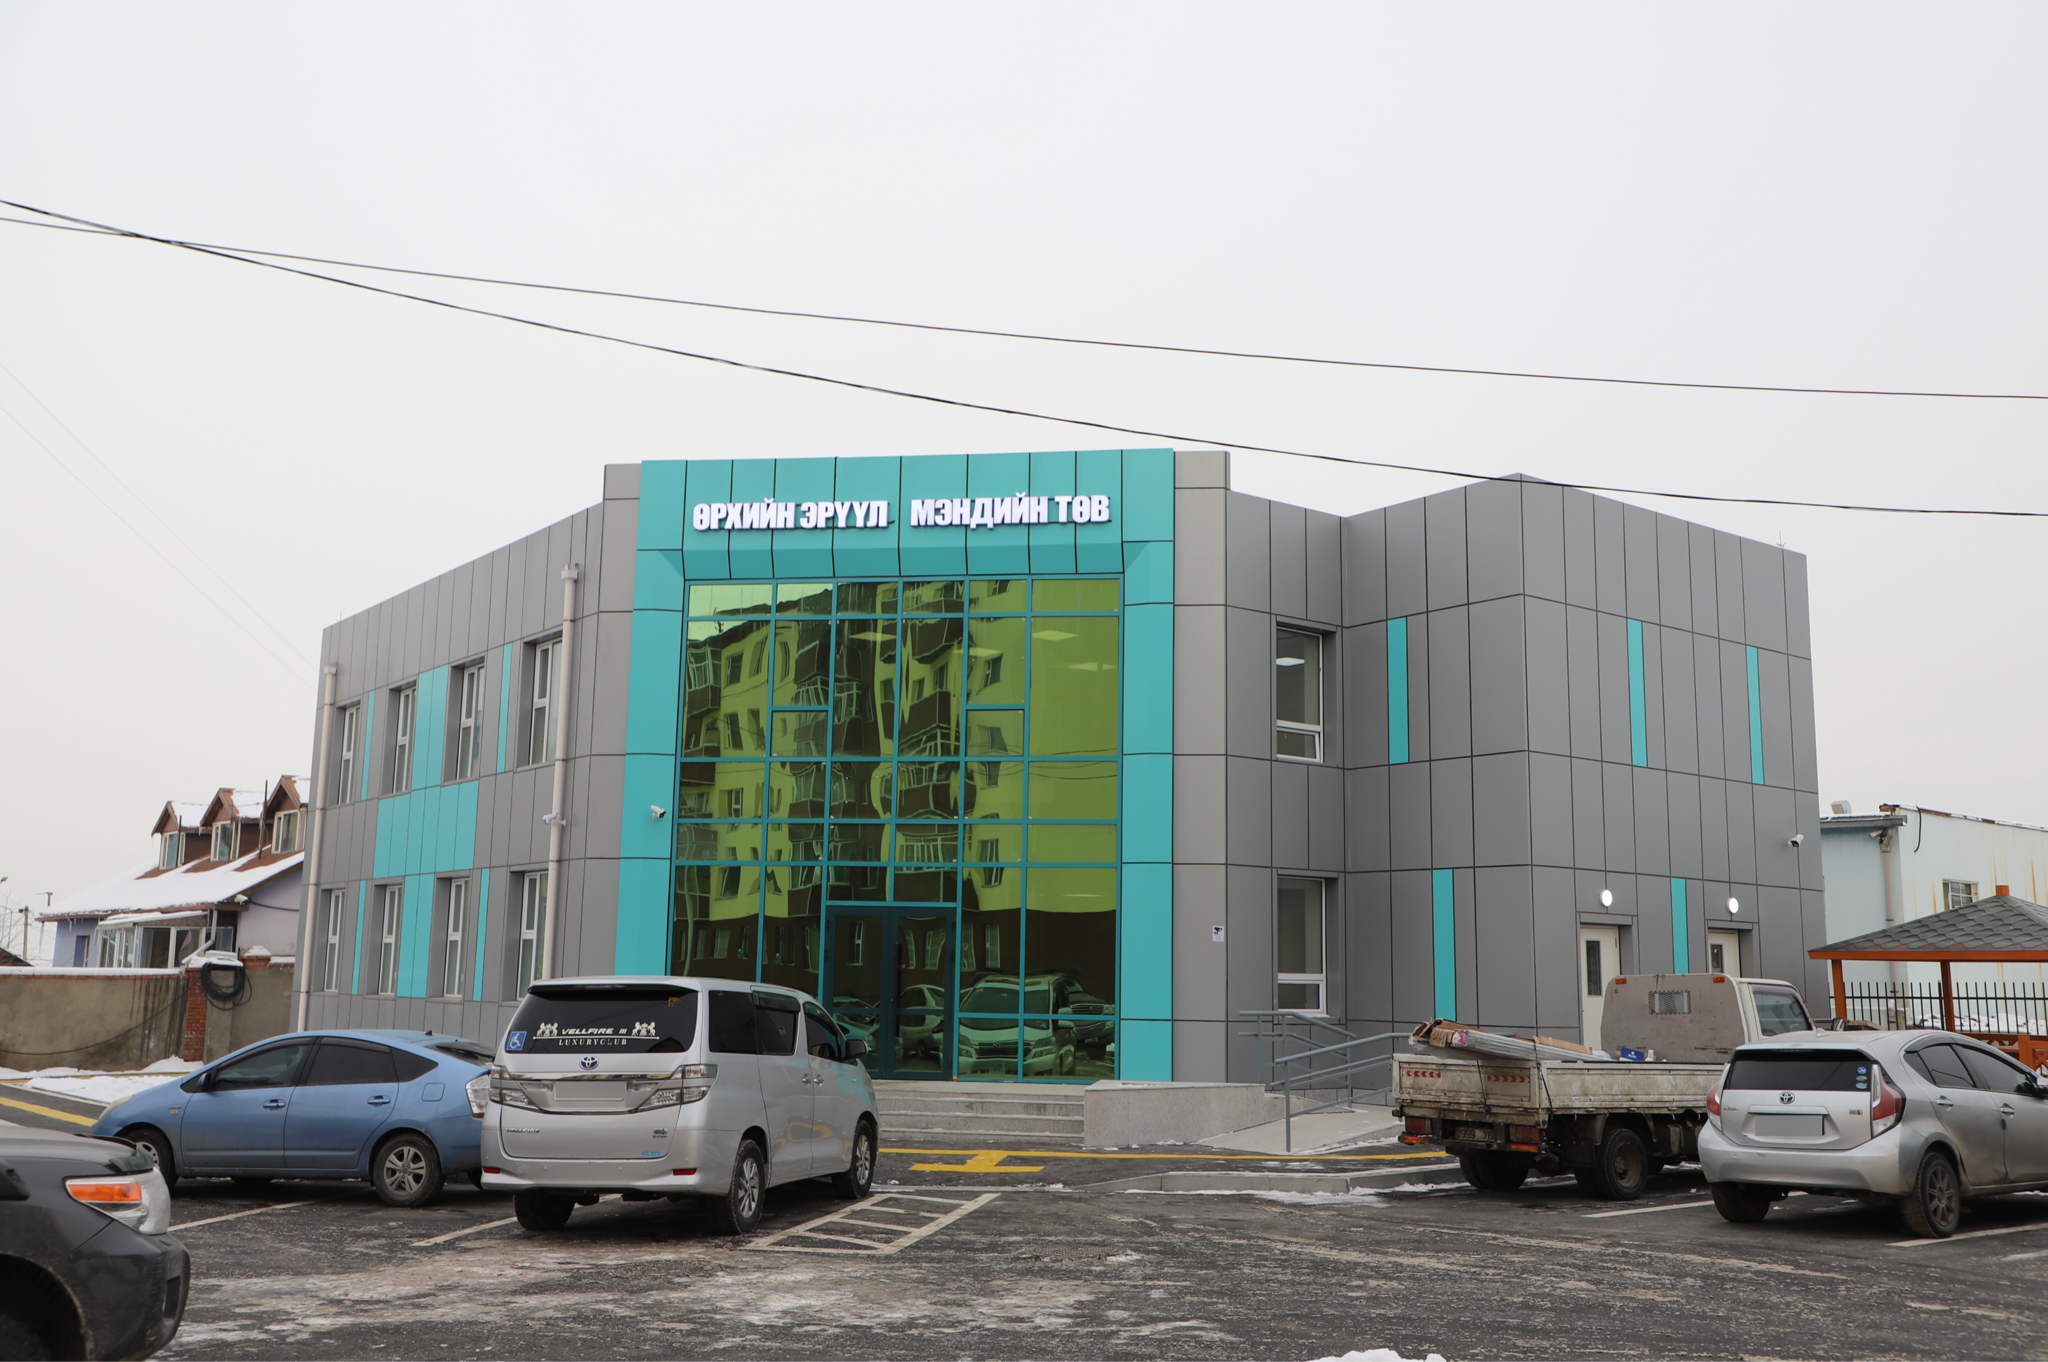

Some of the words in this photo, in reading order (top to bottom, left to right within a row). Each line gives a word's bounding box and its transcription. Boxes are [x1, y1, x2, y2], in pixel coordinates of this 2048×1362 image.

[693, 497, 796, 531] ӨРХИЙН
[800, 500, 889, 529] ЭРҮҮЛ
[910, 491, 1049, 529] МЭНДИЙН
[1054, 495, 1110, 524] ТӨВ
